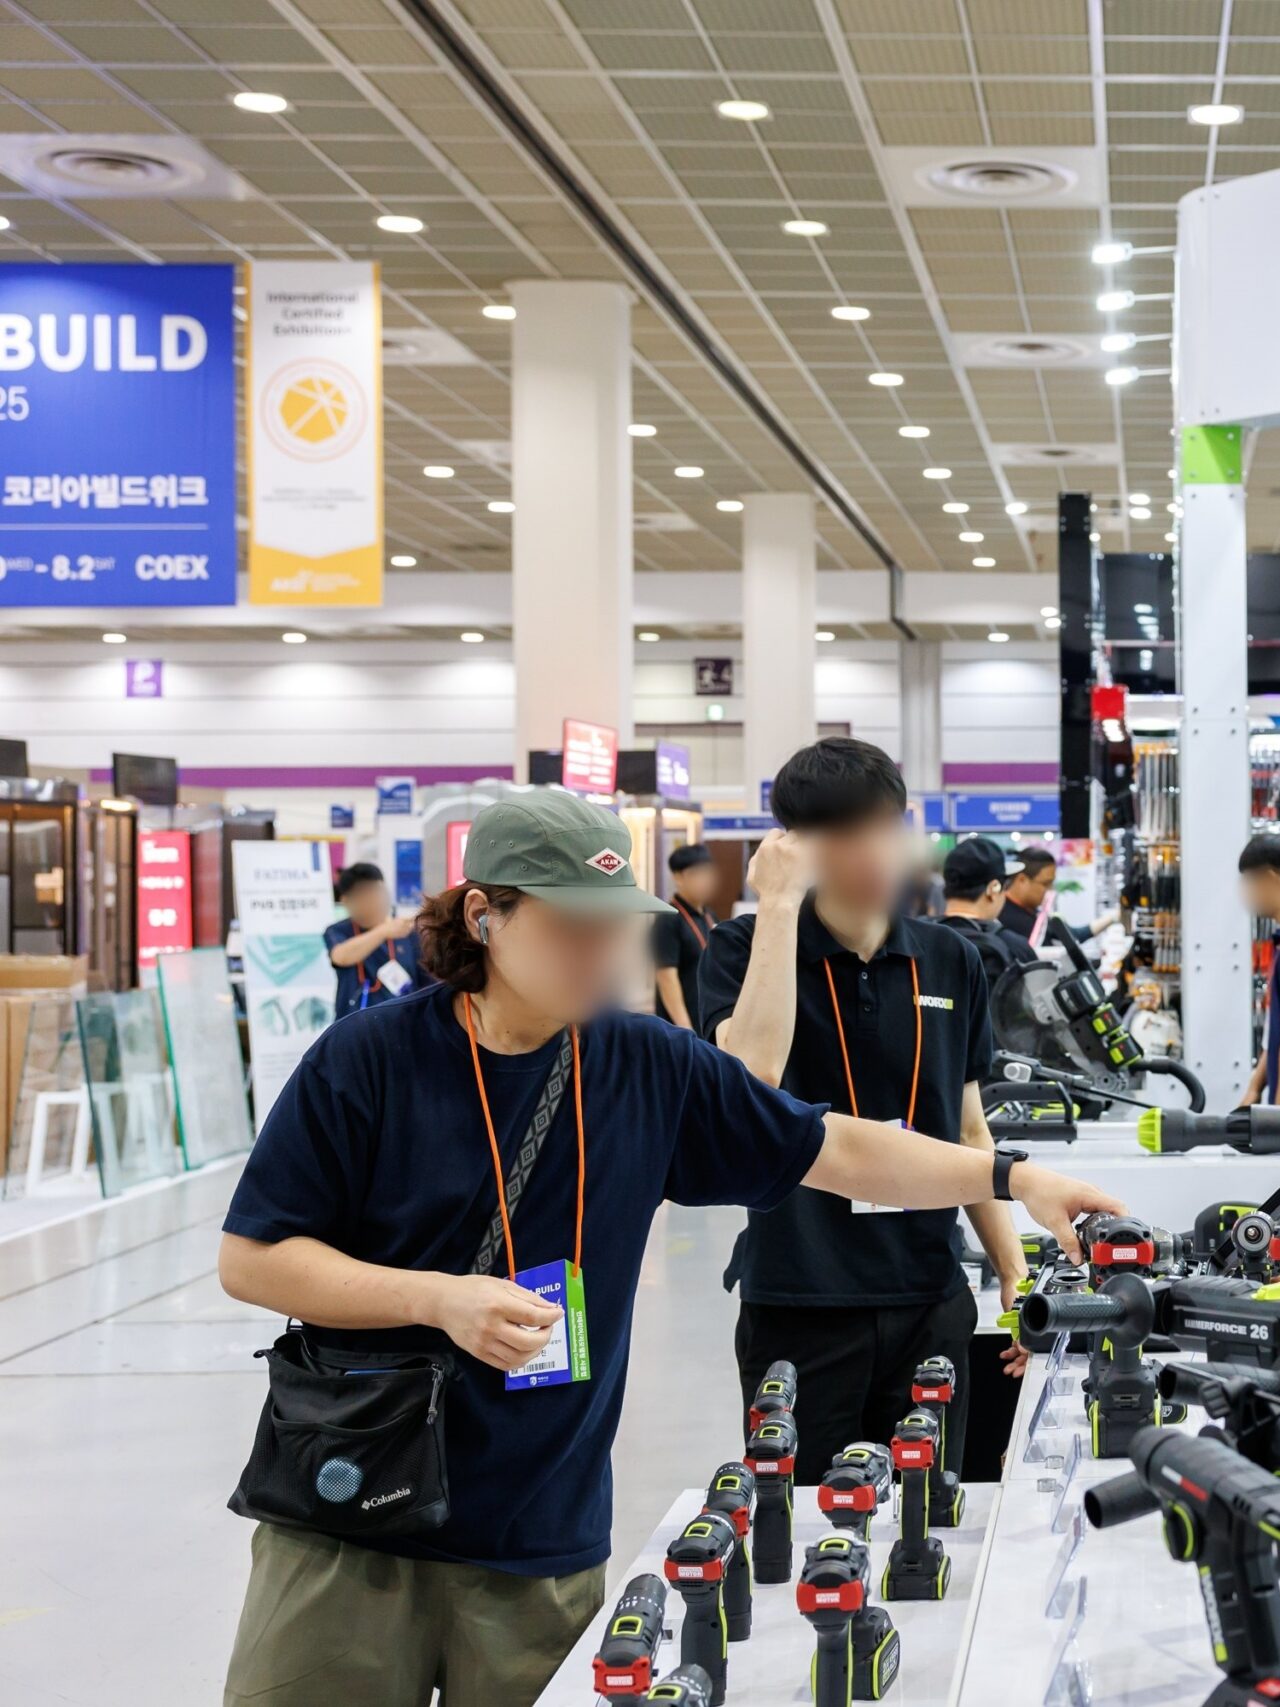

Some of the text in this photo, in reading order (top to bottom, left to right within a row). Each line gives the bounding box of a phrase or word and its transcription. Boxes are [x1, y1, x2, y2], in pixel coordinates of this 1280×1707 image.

[0, 314, 208, 372] BUILD
[3, 474, 209, 508] 코리아빌드위크
[136, 554, 209, 580] COEX
[535, 1282, 561, 1295] BUILD
[1250, 1324, 1269, 1340] 26
[370, 1488, 411, 1507] Columbia
